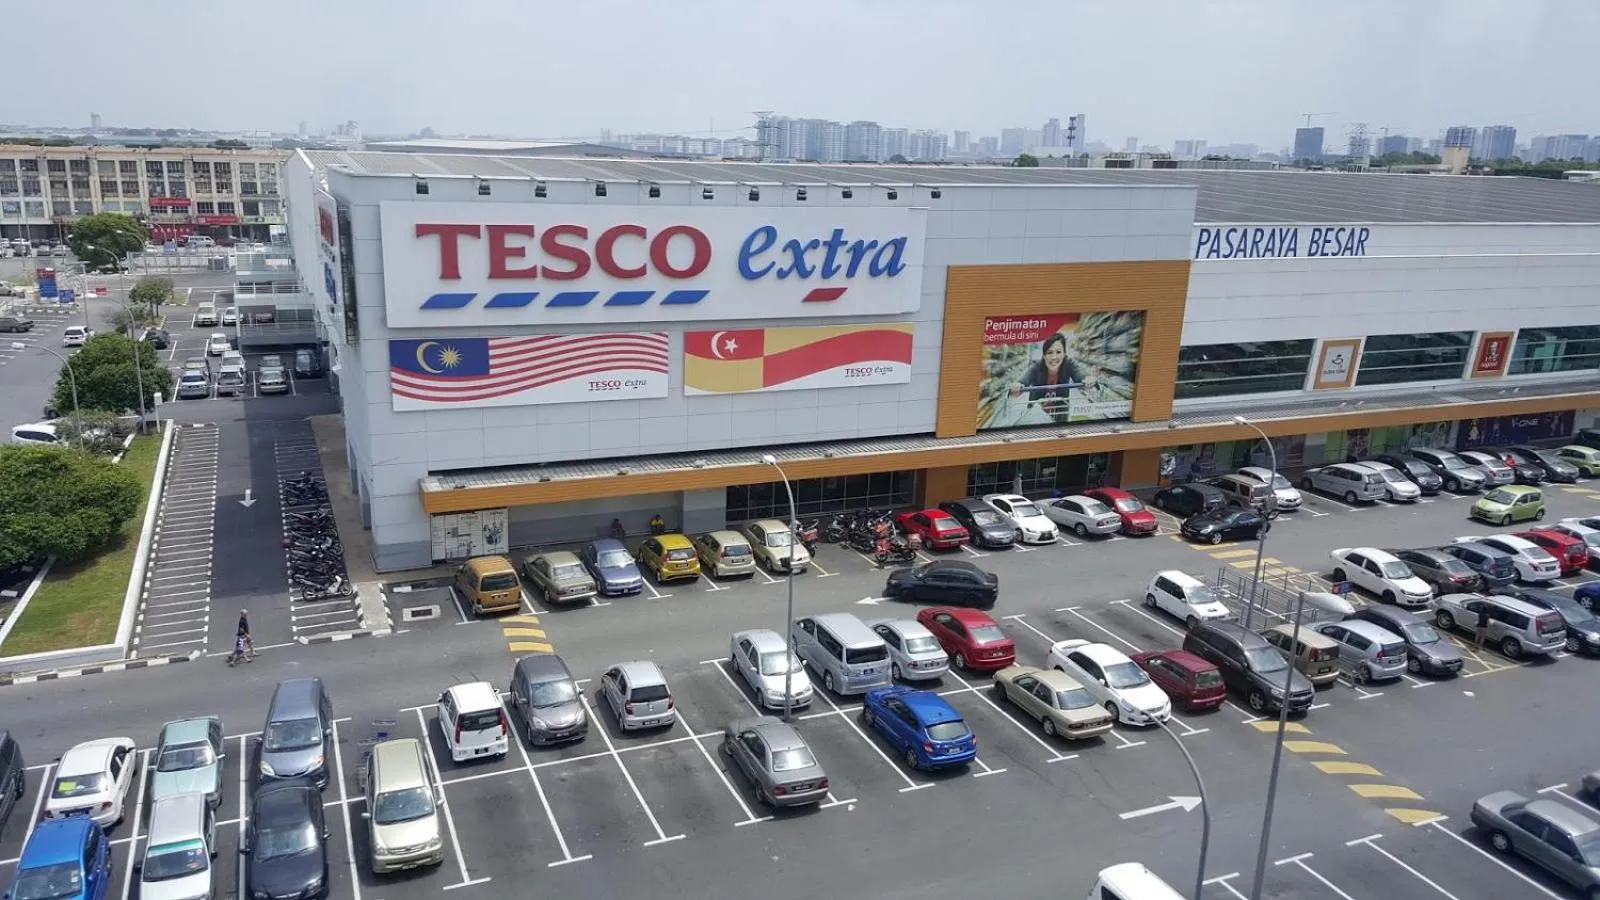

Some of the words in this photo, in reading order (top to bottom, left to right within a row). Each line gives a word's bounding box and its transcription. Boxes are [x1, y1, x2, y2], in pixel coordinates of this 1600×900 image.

[1195, 228, 1298, 259] PASARAYA
[1307, 227, 1370, 257] BESAR
[415, 223, 712, 280] TESCO
[738, 225, 908, 280] extra
[986, 318, 1047, 332] Penjimatan
[984, 331, 1016, 342] bermula
[1017, 331, 1025, 340] di
[1025, 331, 1039, 340] sini
[844, 367, 873, 375] TESCO
[588, 380, 621, 388] TESCO
